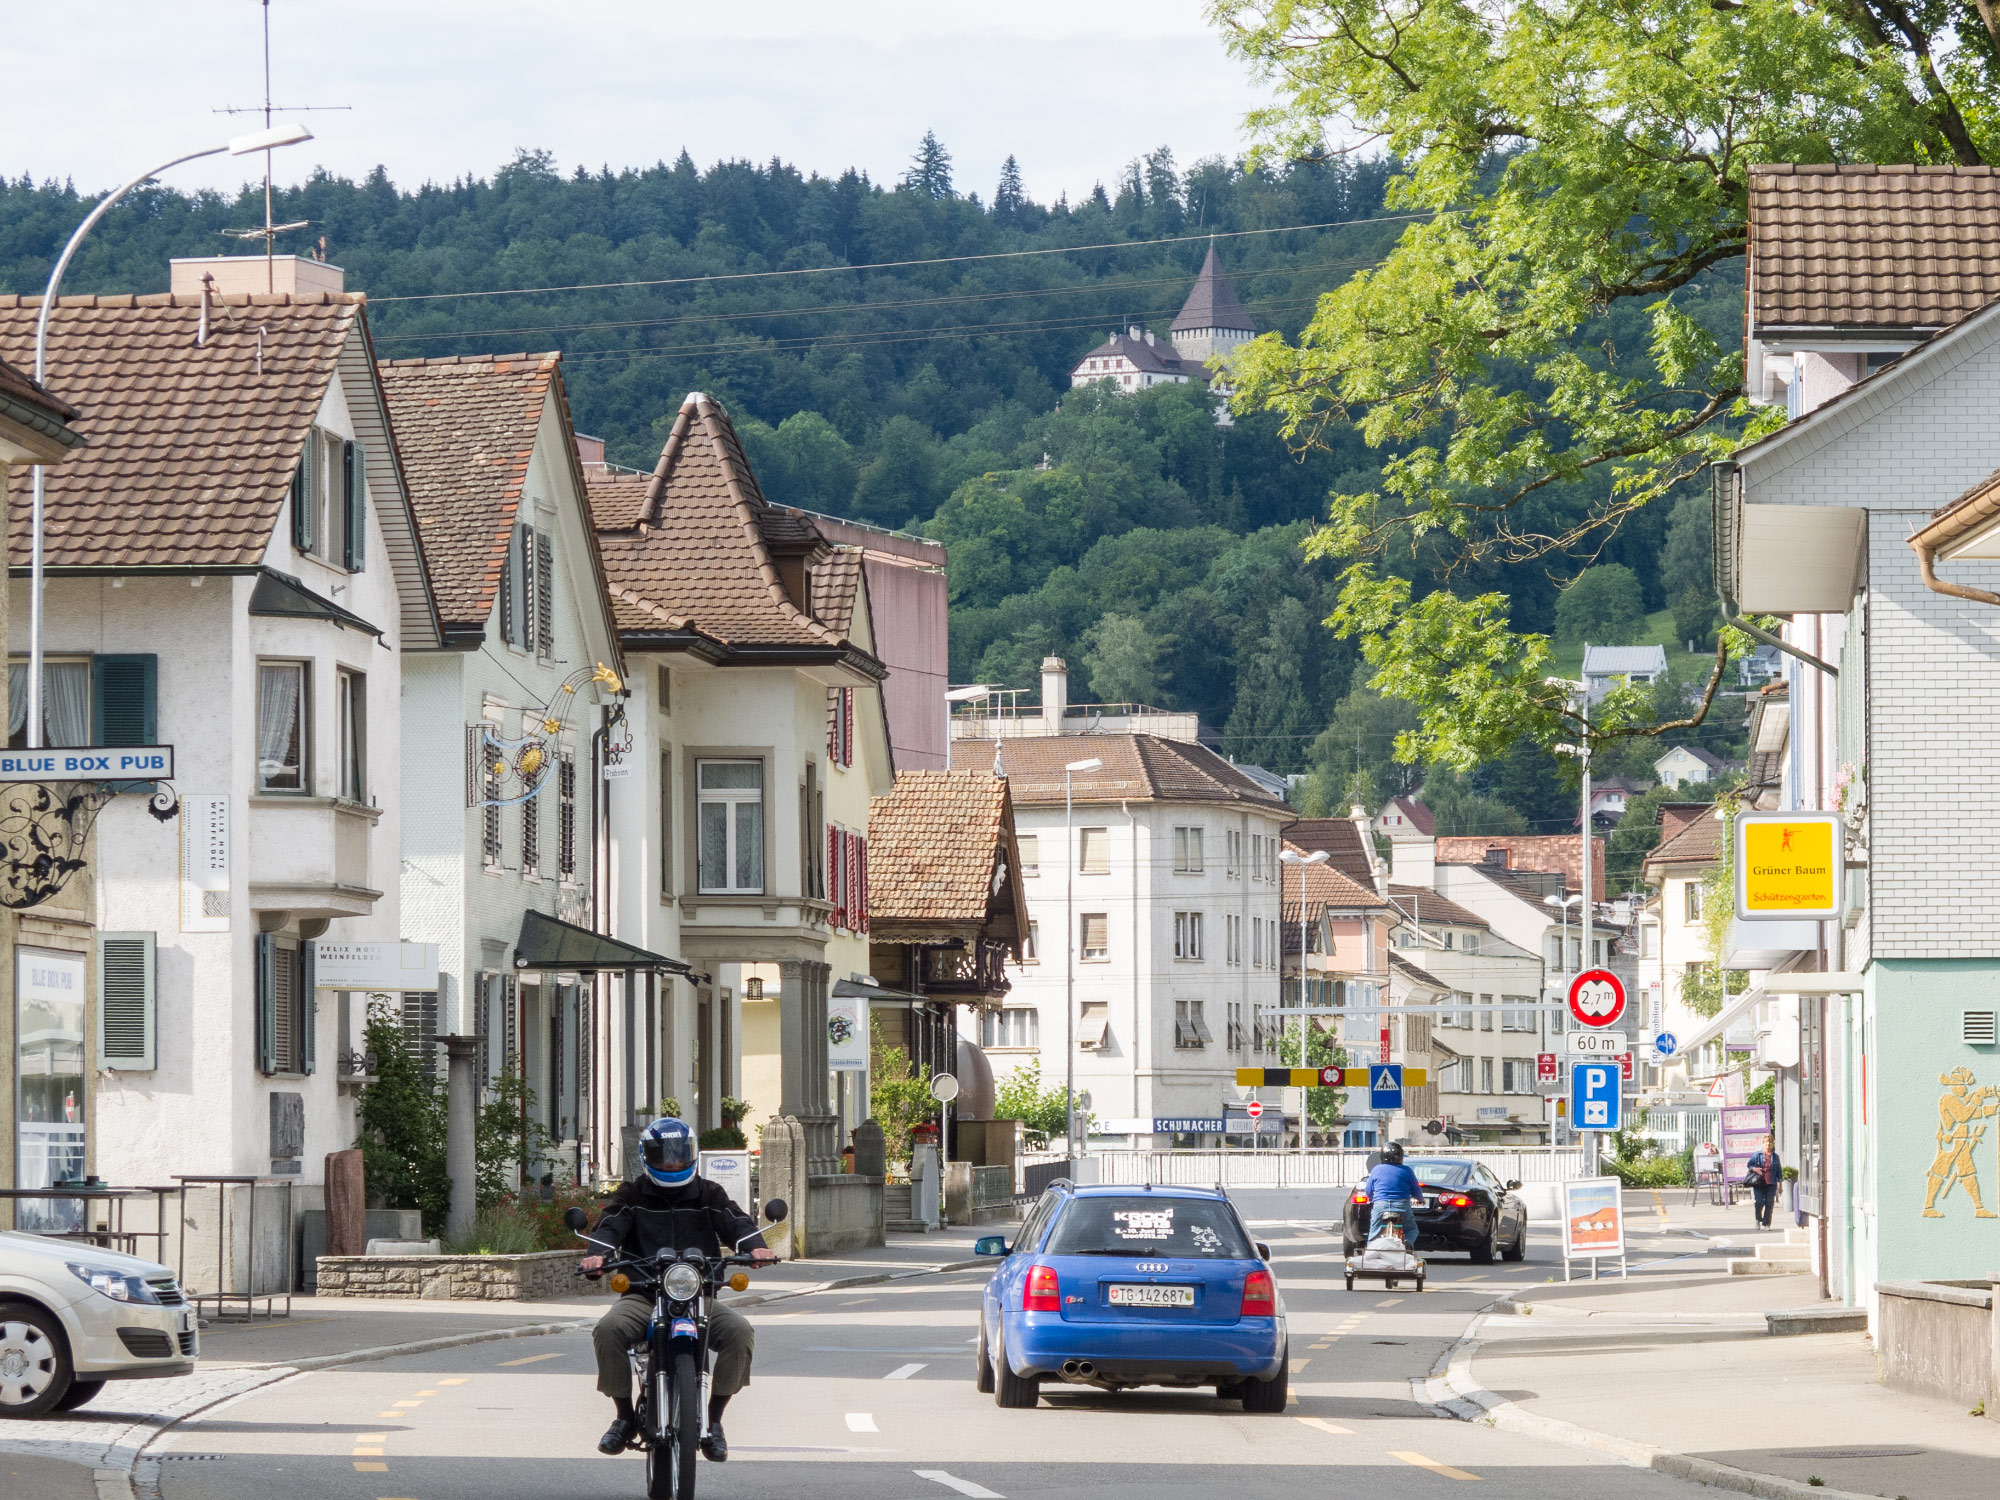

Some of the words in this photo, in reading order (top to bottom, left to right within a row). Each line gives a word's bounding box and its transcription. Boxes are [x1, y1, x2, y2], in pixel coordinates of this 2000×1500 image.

[1, 758, 55, 772] BLUE
[65, 757, 110, 771] BOX
[121, 755, 164, 770] PUB
[1753, 866, 1792, 875] Grüner
[1795, 866, 1826, 875] Baum
[1753, 892, 1827, 905] Schützengarten
[1577, 1036, 1597, 1050] 60
[1601, 1039, 1615, 1050] m
[1586, 1068, 1607, 1099] P
[1156, 1119, 1223, 1132] SCHUMACHER
